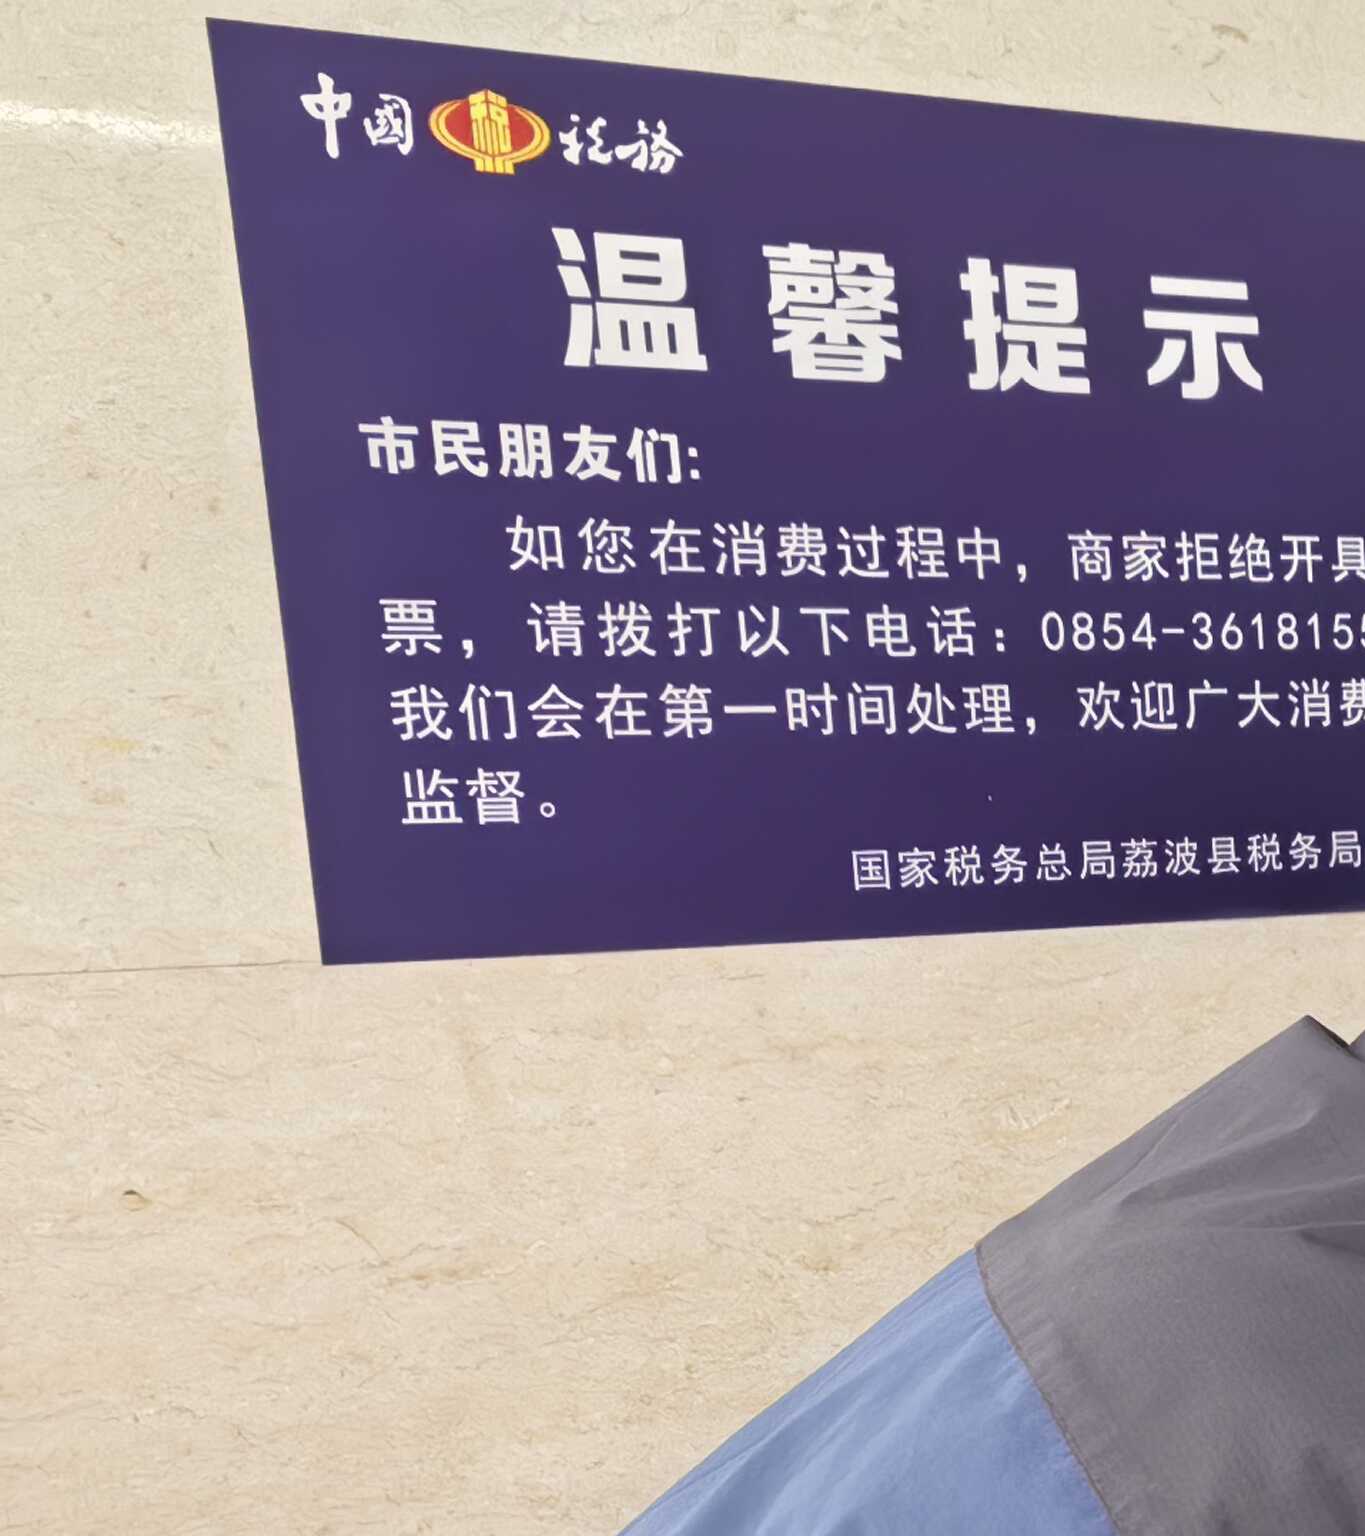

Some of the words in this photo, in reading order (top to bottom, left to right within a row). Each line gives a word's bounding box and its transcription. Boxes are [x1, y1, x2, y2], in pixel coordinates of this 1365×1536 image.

[551, 226, 1264, 401] 温馨提示
[358, 415, 700, 484] 市民朋友们：
[401, 767, 557, 826] 监督。
[851, 829, 1363, 892] 国家税务总局荔波县税务局
